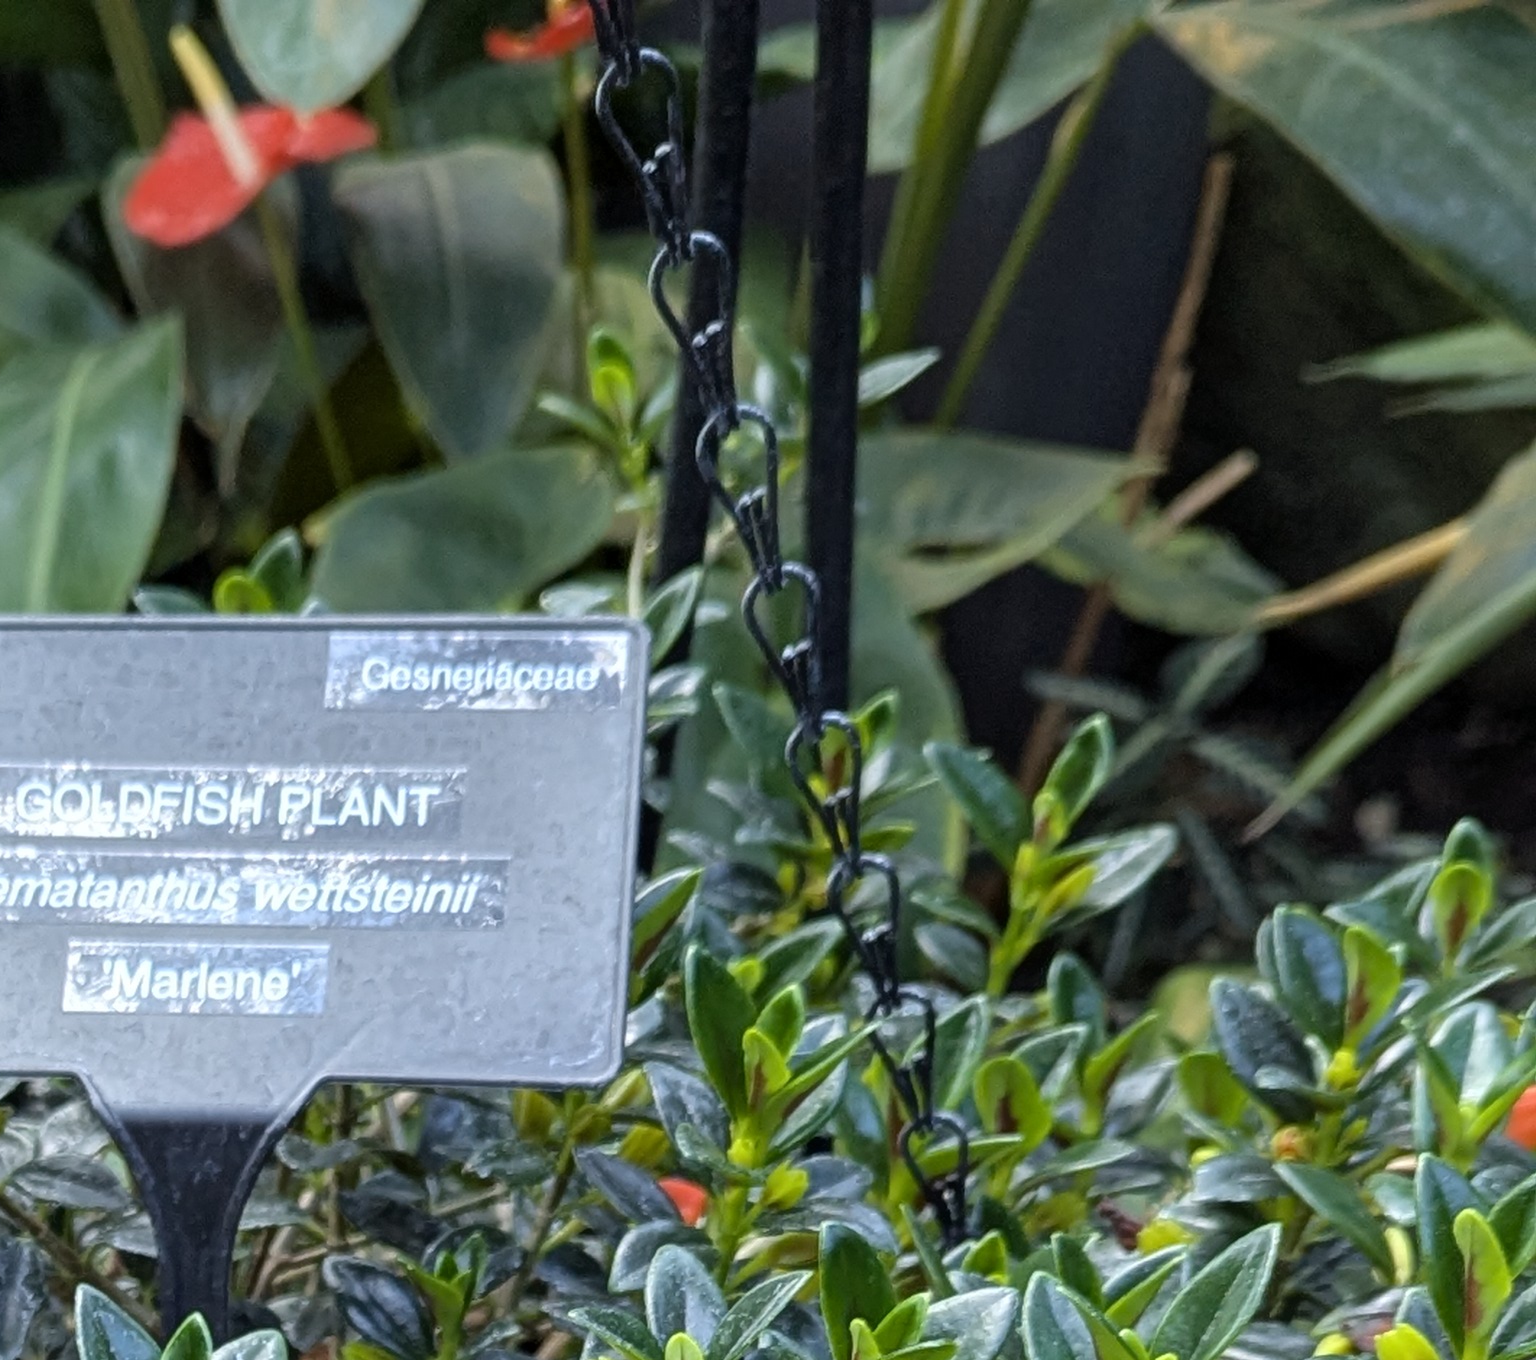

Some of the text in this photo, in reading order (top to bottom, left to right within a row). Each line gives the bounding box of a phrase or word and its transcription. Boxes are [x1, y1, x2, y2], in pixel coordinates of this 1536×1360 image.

[362, 658, 600, 692] Gesneriaceae
[16, 781, 441, 828] GOLDFISH PLANT
[256, 872, 480, 915] wettsteinii
[102, 960, 301, 1002] 'Marlene'
